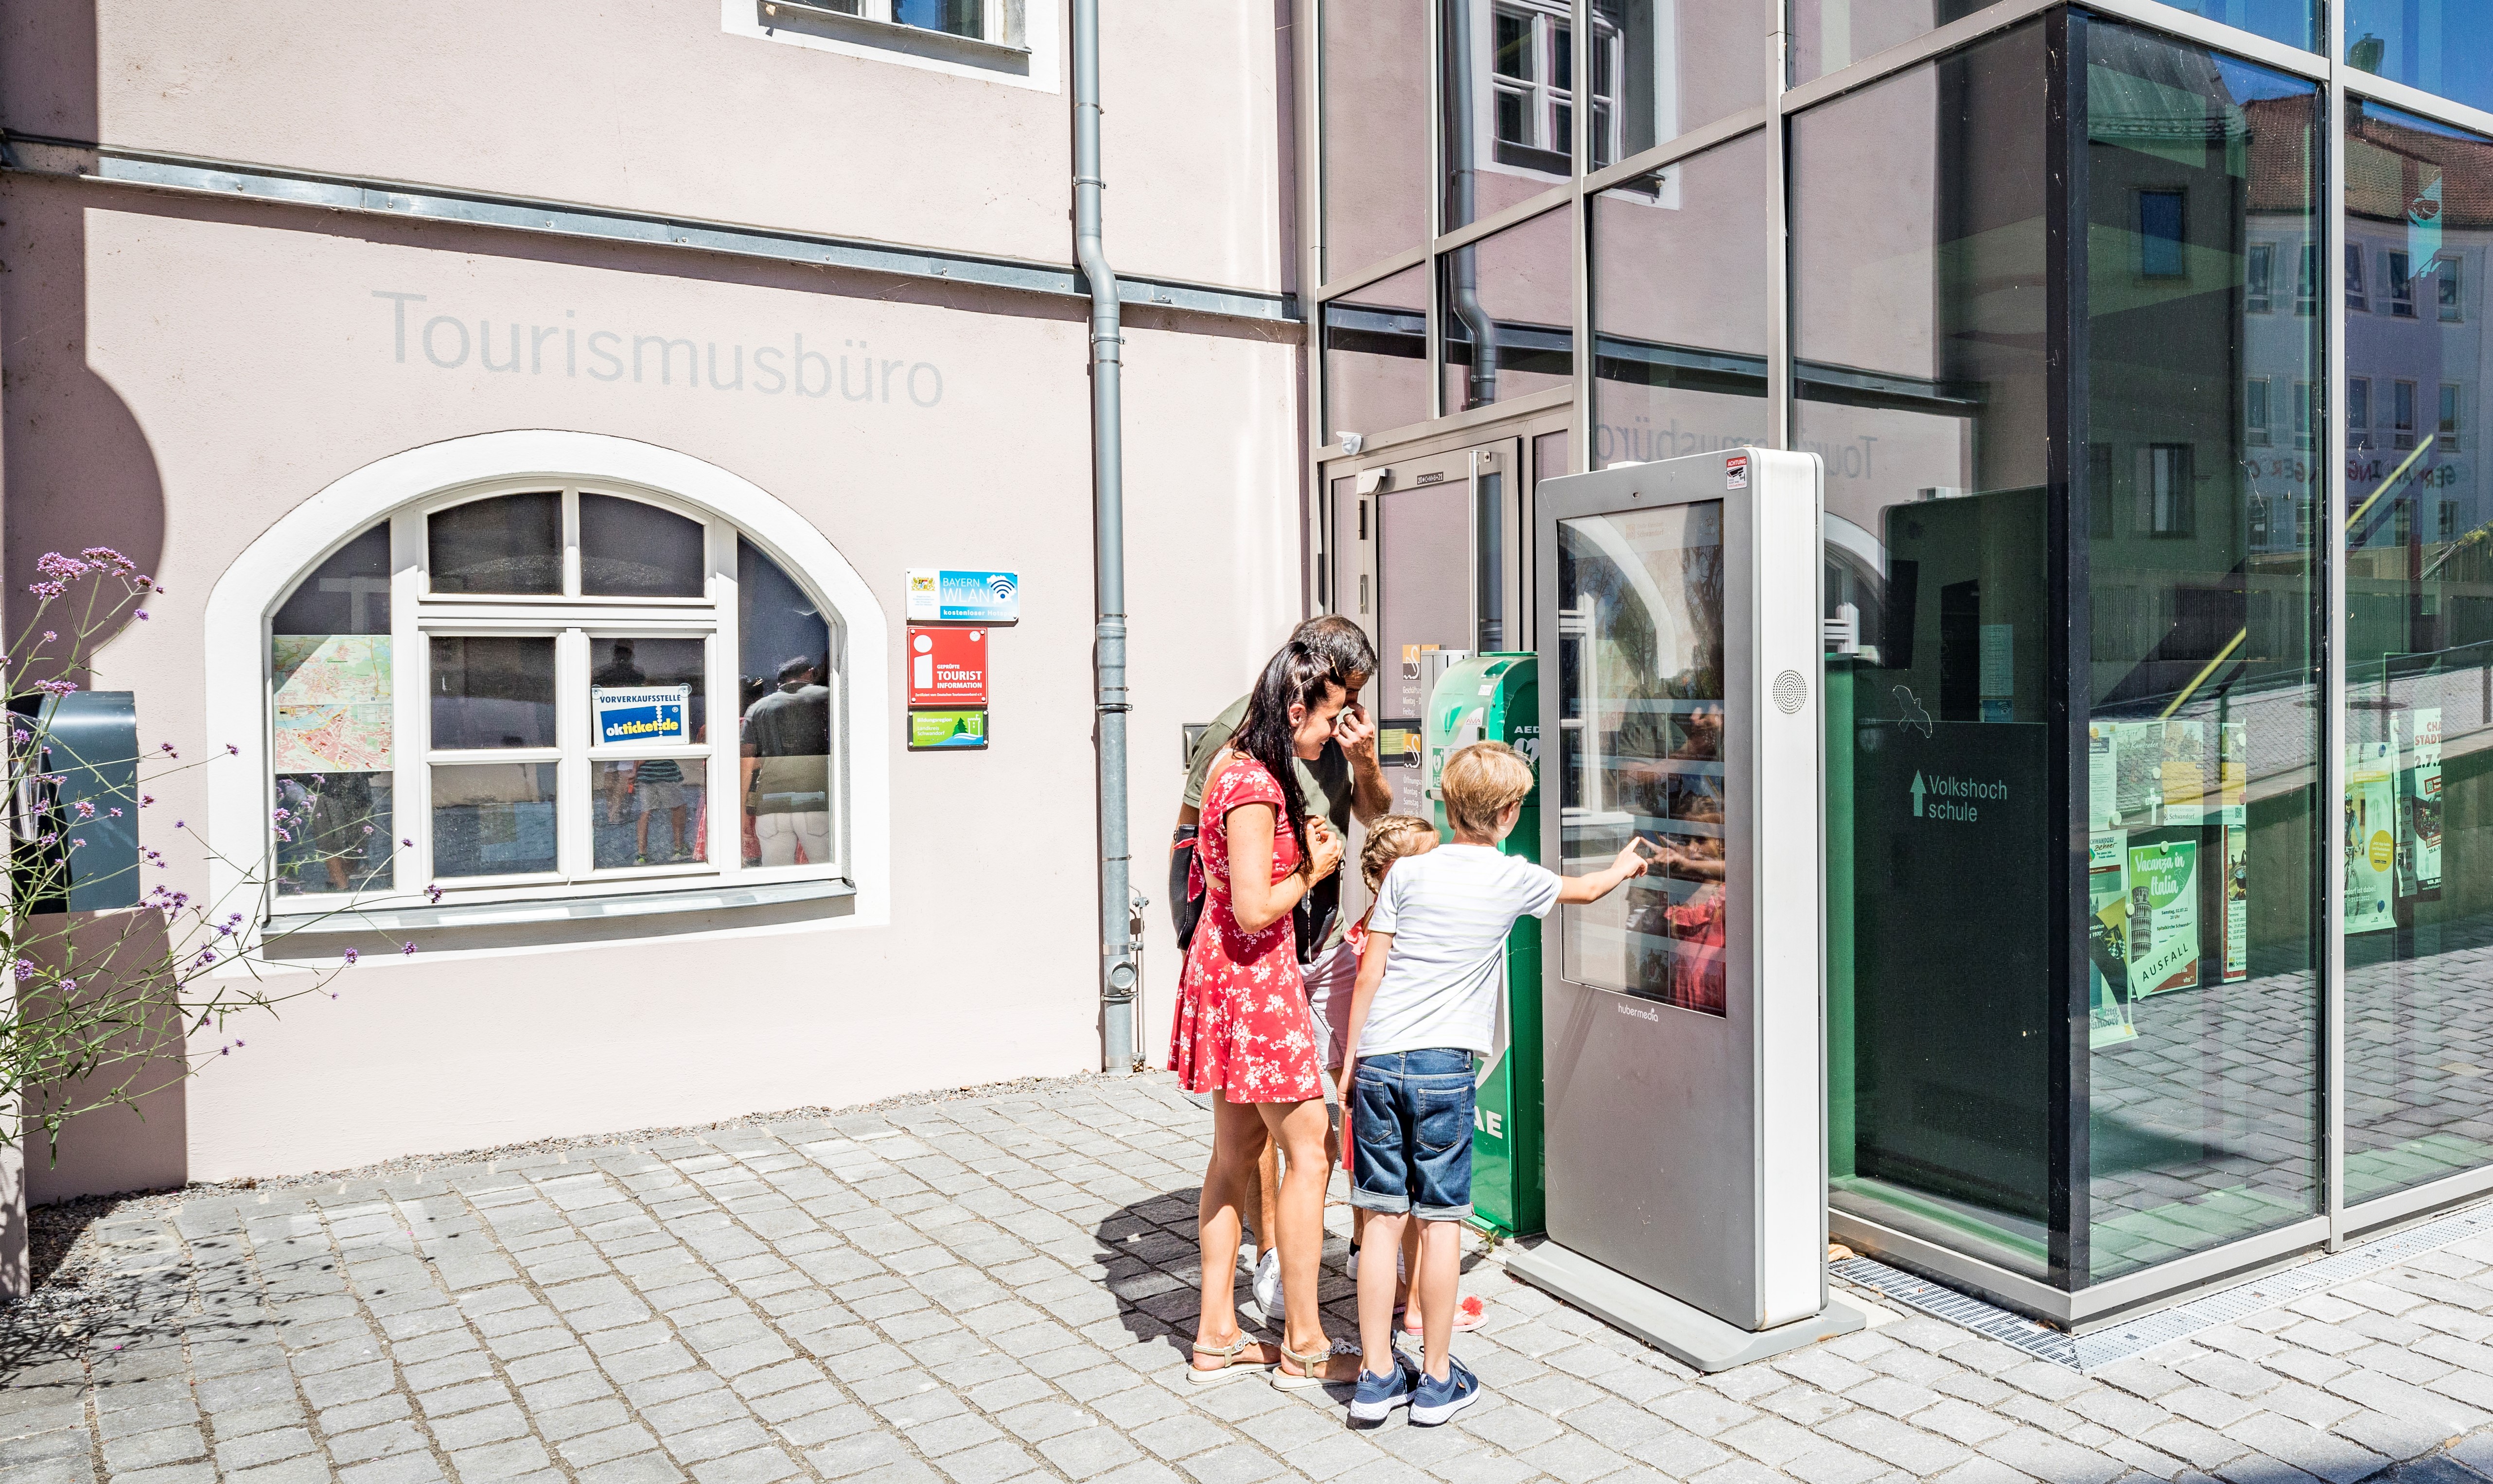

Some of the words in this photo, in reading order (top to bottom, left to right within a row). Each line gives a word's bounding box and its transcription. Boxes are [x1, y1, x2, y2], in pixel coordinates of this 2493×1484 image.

[371, 289, 944, 408] Tourismusbüro
[1727, 458, 1746, 467] ACHTUNG
[1637, 528, 1664, 538] Schwandorf
[943, 577, 980, 587] BAYERN
[943, 588, 990, 603] WLAN
[936, 671, 982, 681] TOURIST
[600, 695, 681, 703] VORVERKAUFSSTELLE
[1403, 697, 1415, 706] Montag
[1403, 707, 1415, 717] Freitag:
[606, 718, 679, 736] okticket.de
[1404, 787, 1418, 797] Montag
[1929, 775, 2007, 800] Volkshoch
[1404, 798, 1419, 808] Samstag
[1929, 801, 1977, 822] schule
[2135, 852, 2173, 873] Vacanza
[2175, 852, 2185, 868] in
[2151, 875, 2178, 896] Italia
[2143, 943, 2188, 982] AUSFALL
[1618, 1003, 1658, 1022] hubermedia
